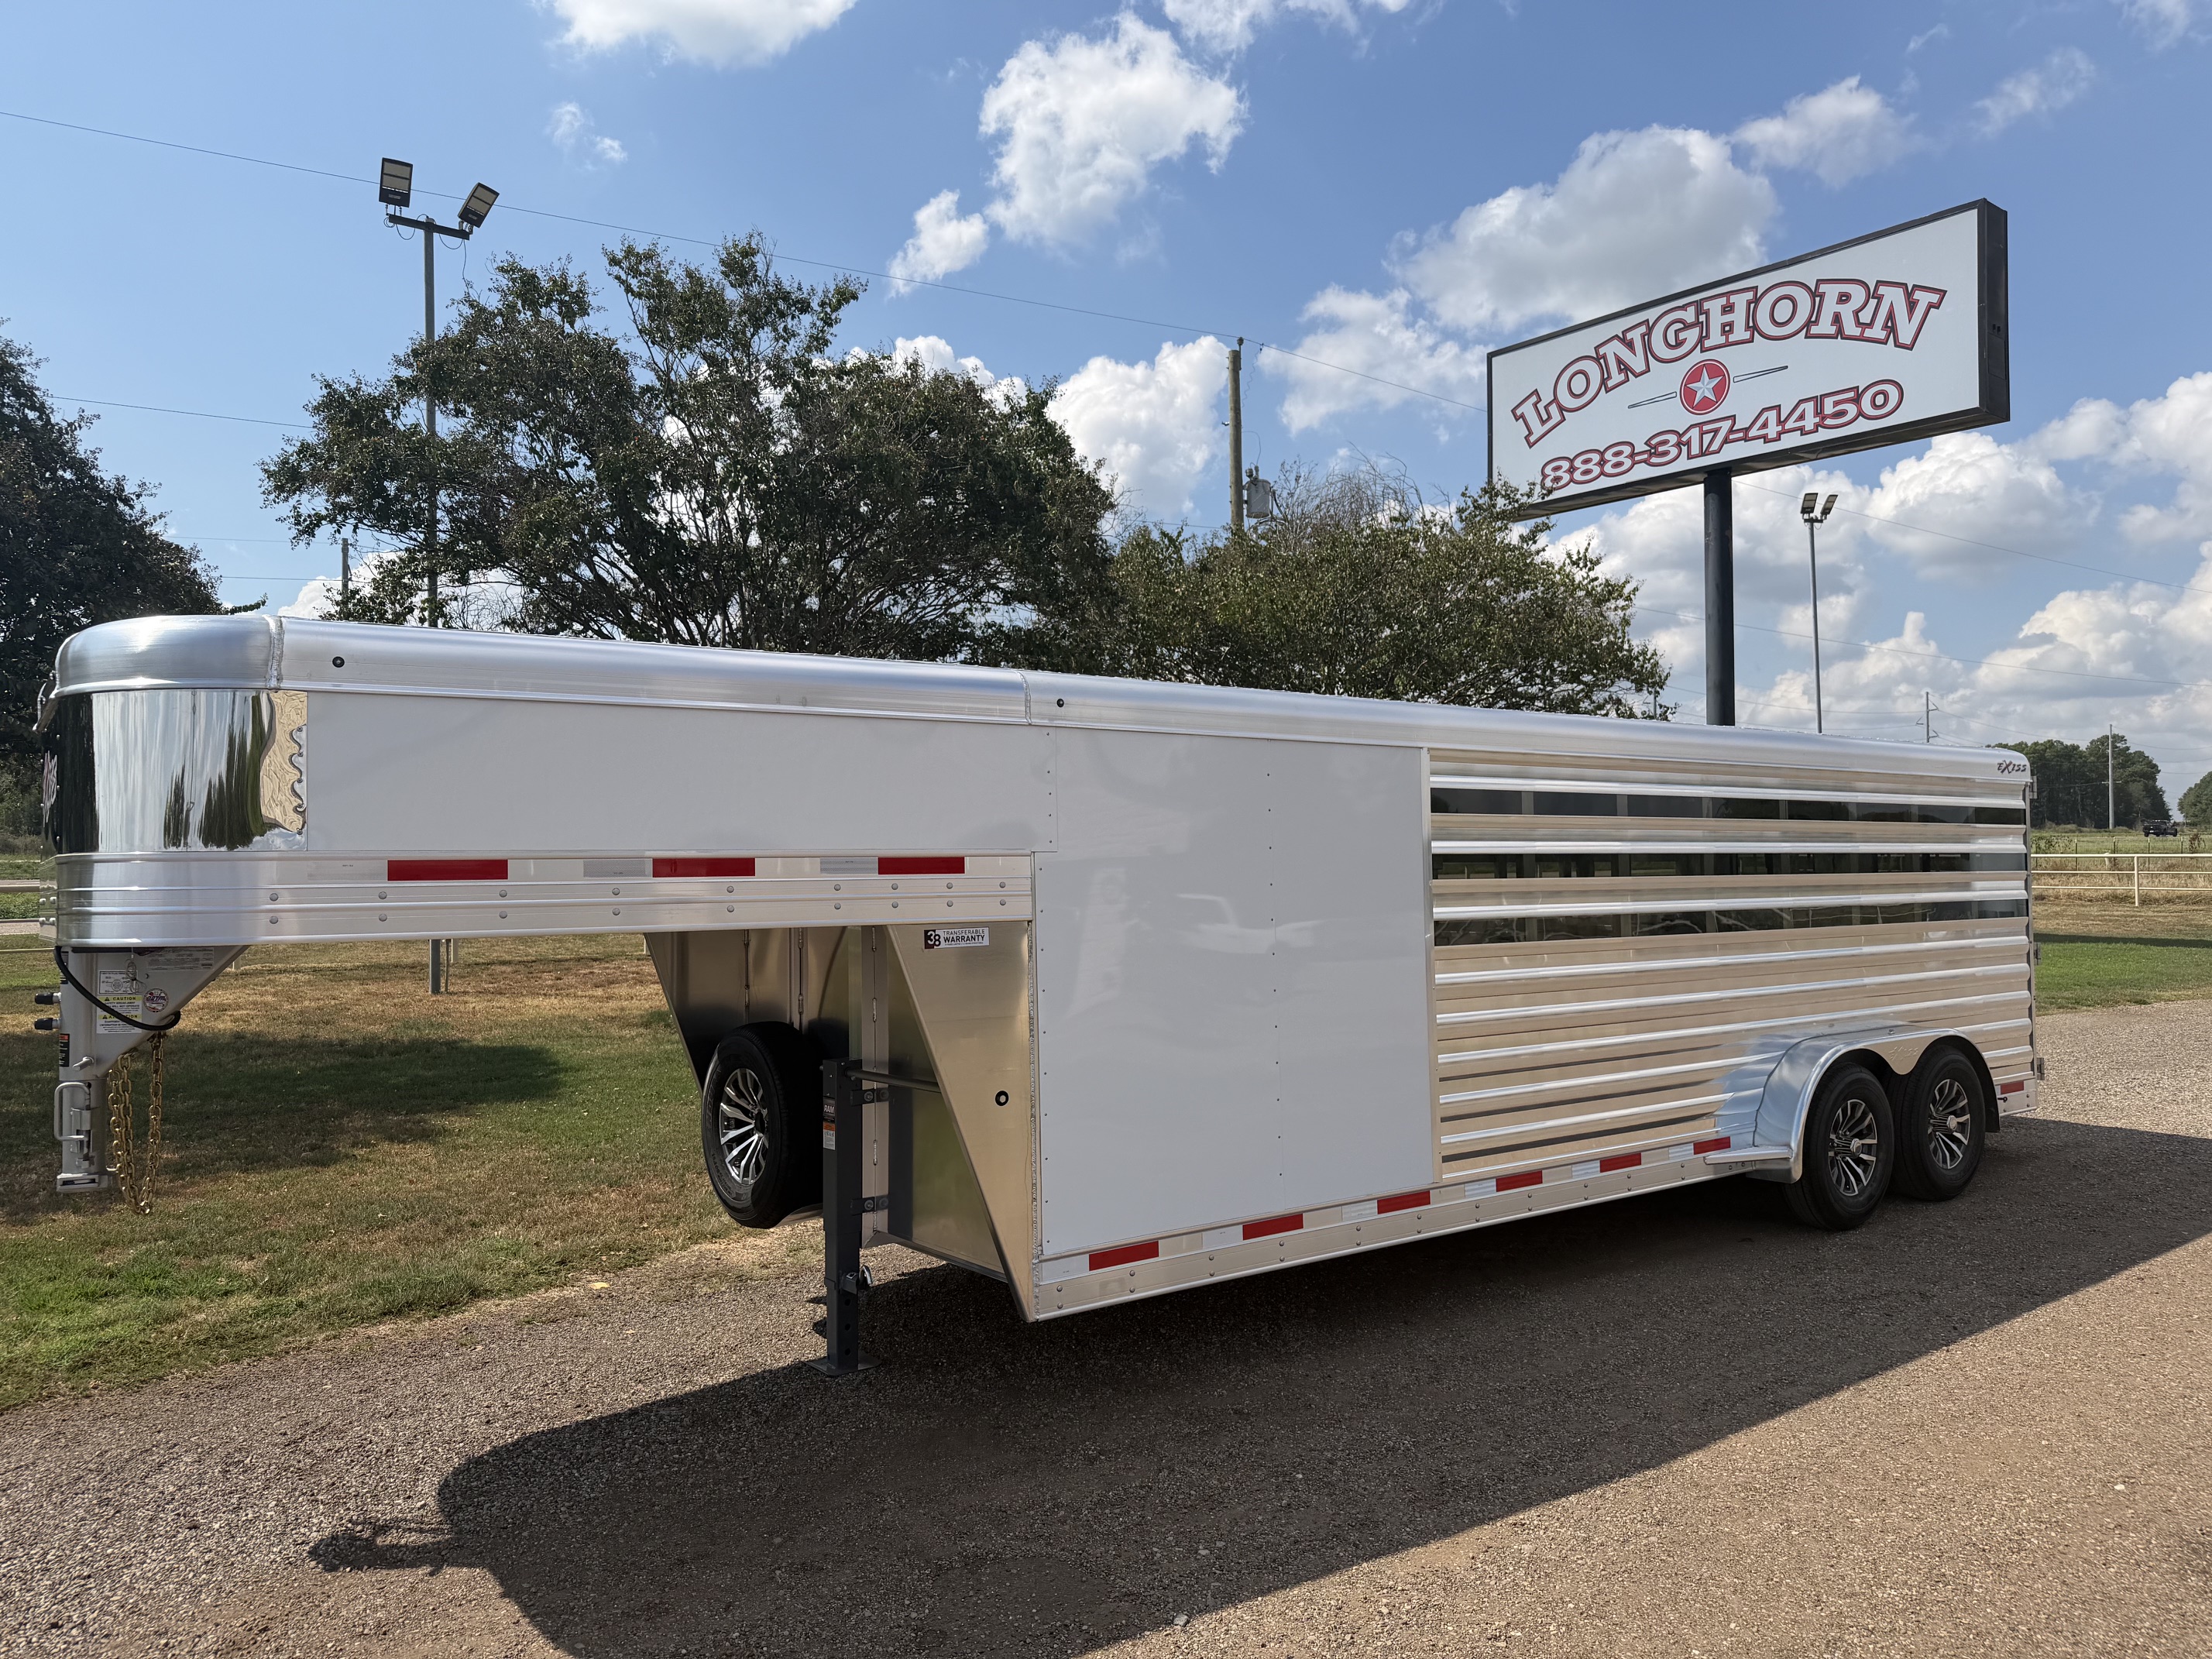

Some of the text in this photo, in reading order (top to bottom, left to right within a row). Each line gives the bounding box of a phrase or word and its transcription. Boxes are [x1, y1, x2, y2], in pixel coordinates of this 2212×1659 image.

[1511, 278, 1947, 448] LONGHORN
[1541, 379, 1905, 490] 888-317-4450
[823, 1104, 835, 1114] RAM
